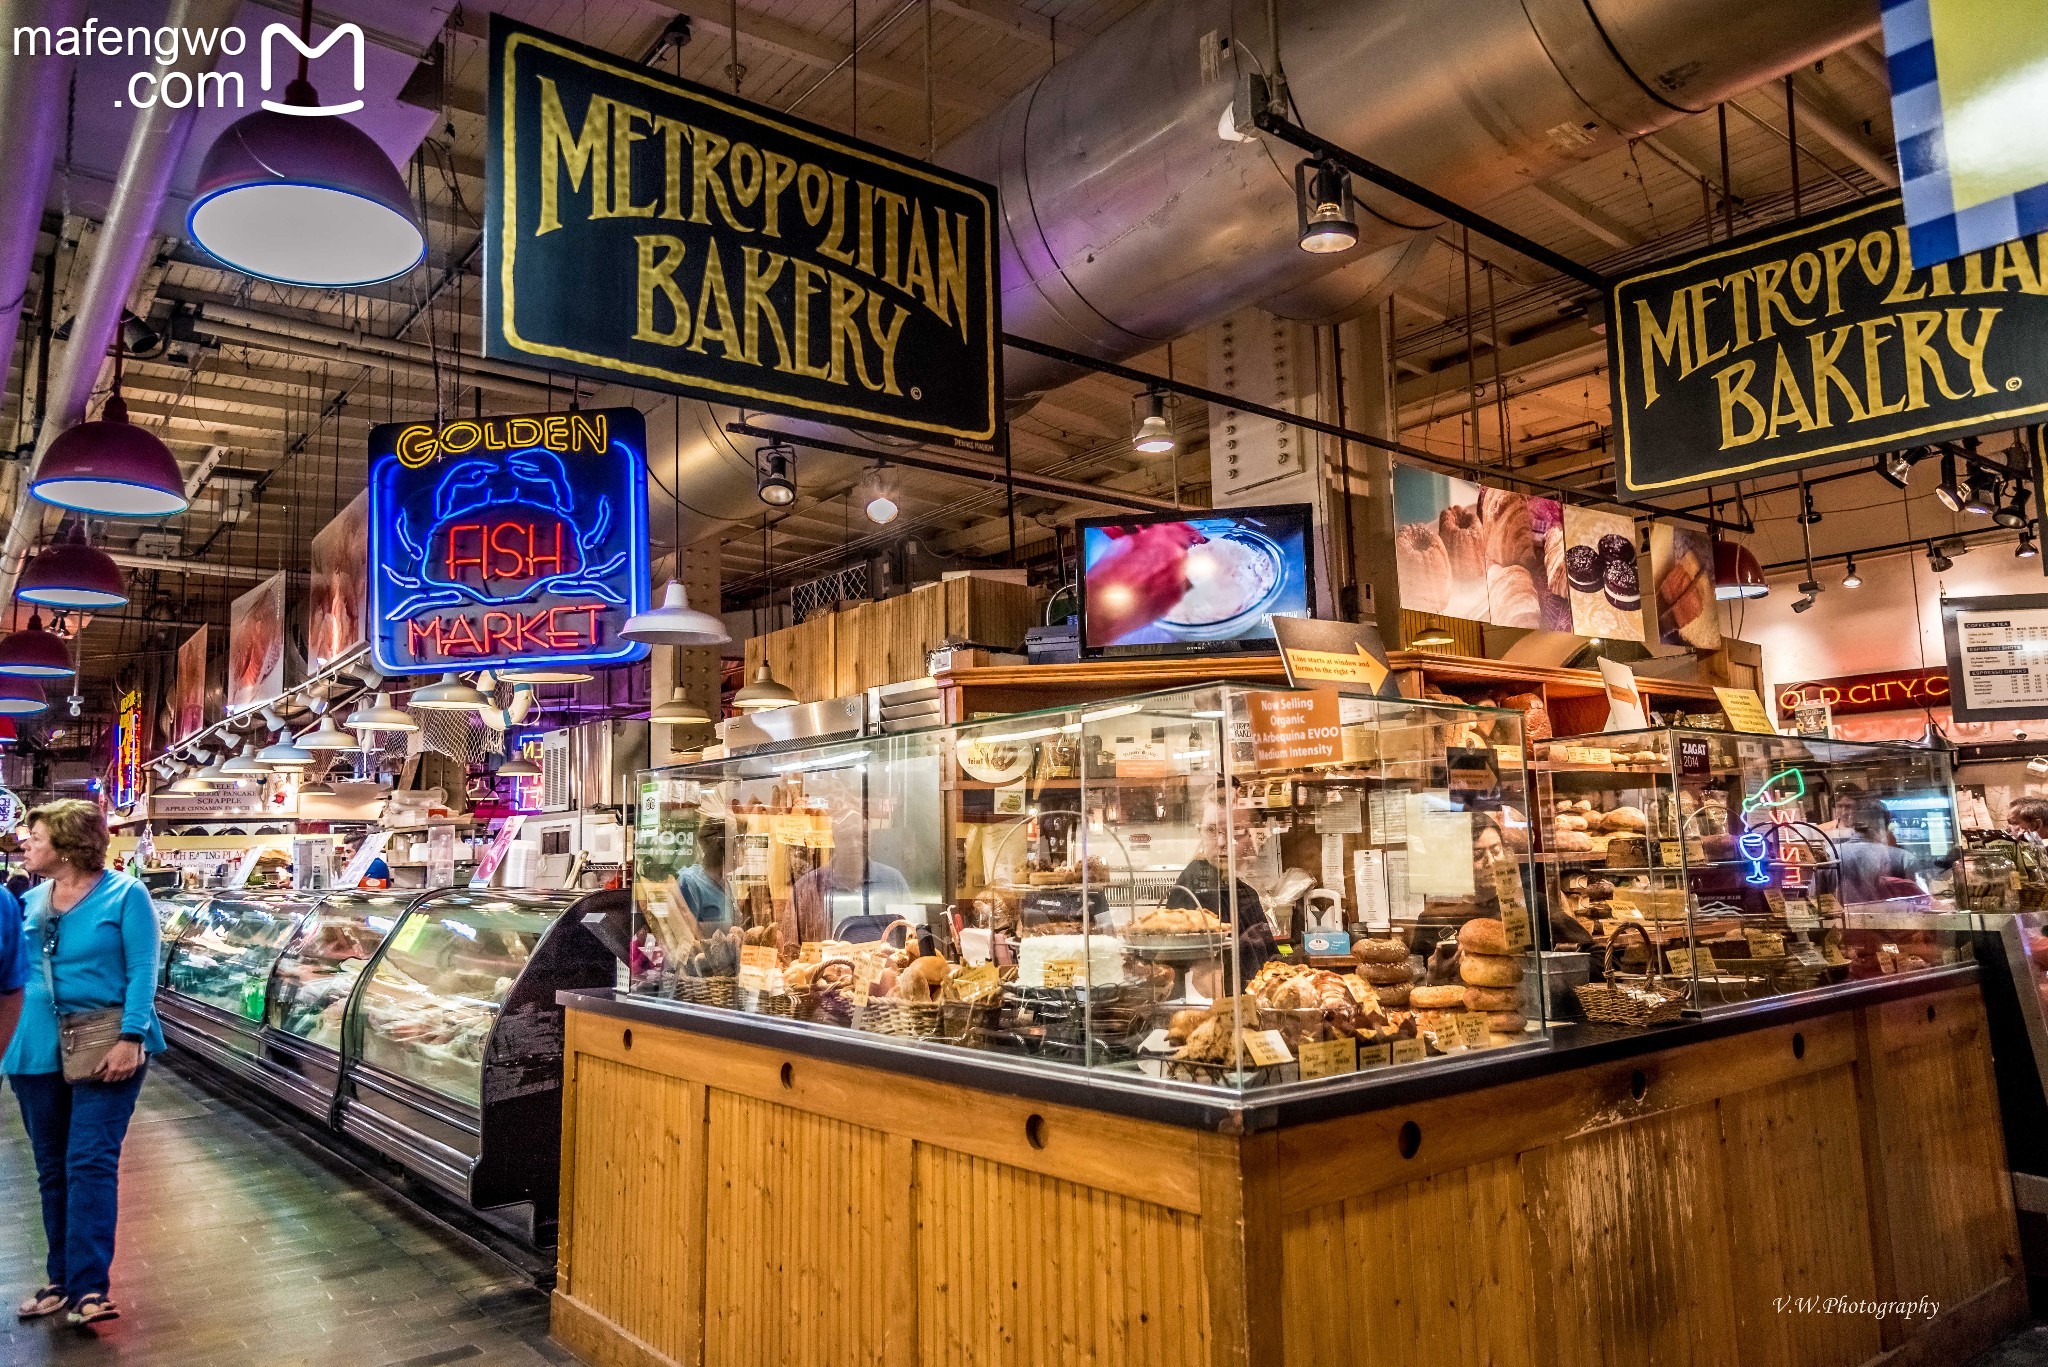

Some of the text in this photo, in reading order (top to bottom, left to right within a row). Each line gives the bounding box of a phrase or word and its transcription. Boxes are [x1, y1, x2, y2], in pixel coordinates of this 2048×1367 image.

[536, 74, 970, 346] METROPOLITAN
[631, 234, 912, 397] BAKERY
[1711, 307, 2004, 451] BAKERY
[396, 414, 607, 469] GOLDEN
[445, 522, 562, 581] FISH
[407, 604, 607, 656] MARKET
[1291, 654, 1307, 663] Line
[1308, 655, 1325, 664] starts
[1333, 657, 1357, 667] window
[1357, 660, 1370, 668] and
[1295, 664, 1314, 673] forms
[1322, 666, 1332, 674] the
[1333, 667, 1350, 676] right
[1780, 687, 1841, 710] OLD
[1849, 679, 1918, 704] CITY
[1261, 698, 1314, 711] Now Selling
[1270, 714, 1305, 728] Organic
[1263, 730, 1306, 745] Arbequina
[1307, 726, 1339, 740] EVOO
[1258, 744, 1333, 760] Medium Intensity
[1681, 742, 1707, 756] ZAGAT
[1683, 756, 1700, 768] 2014
